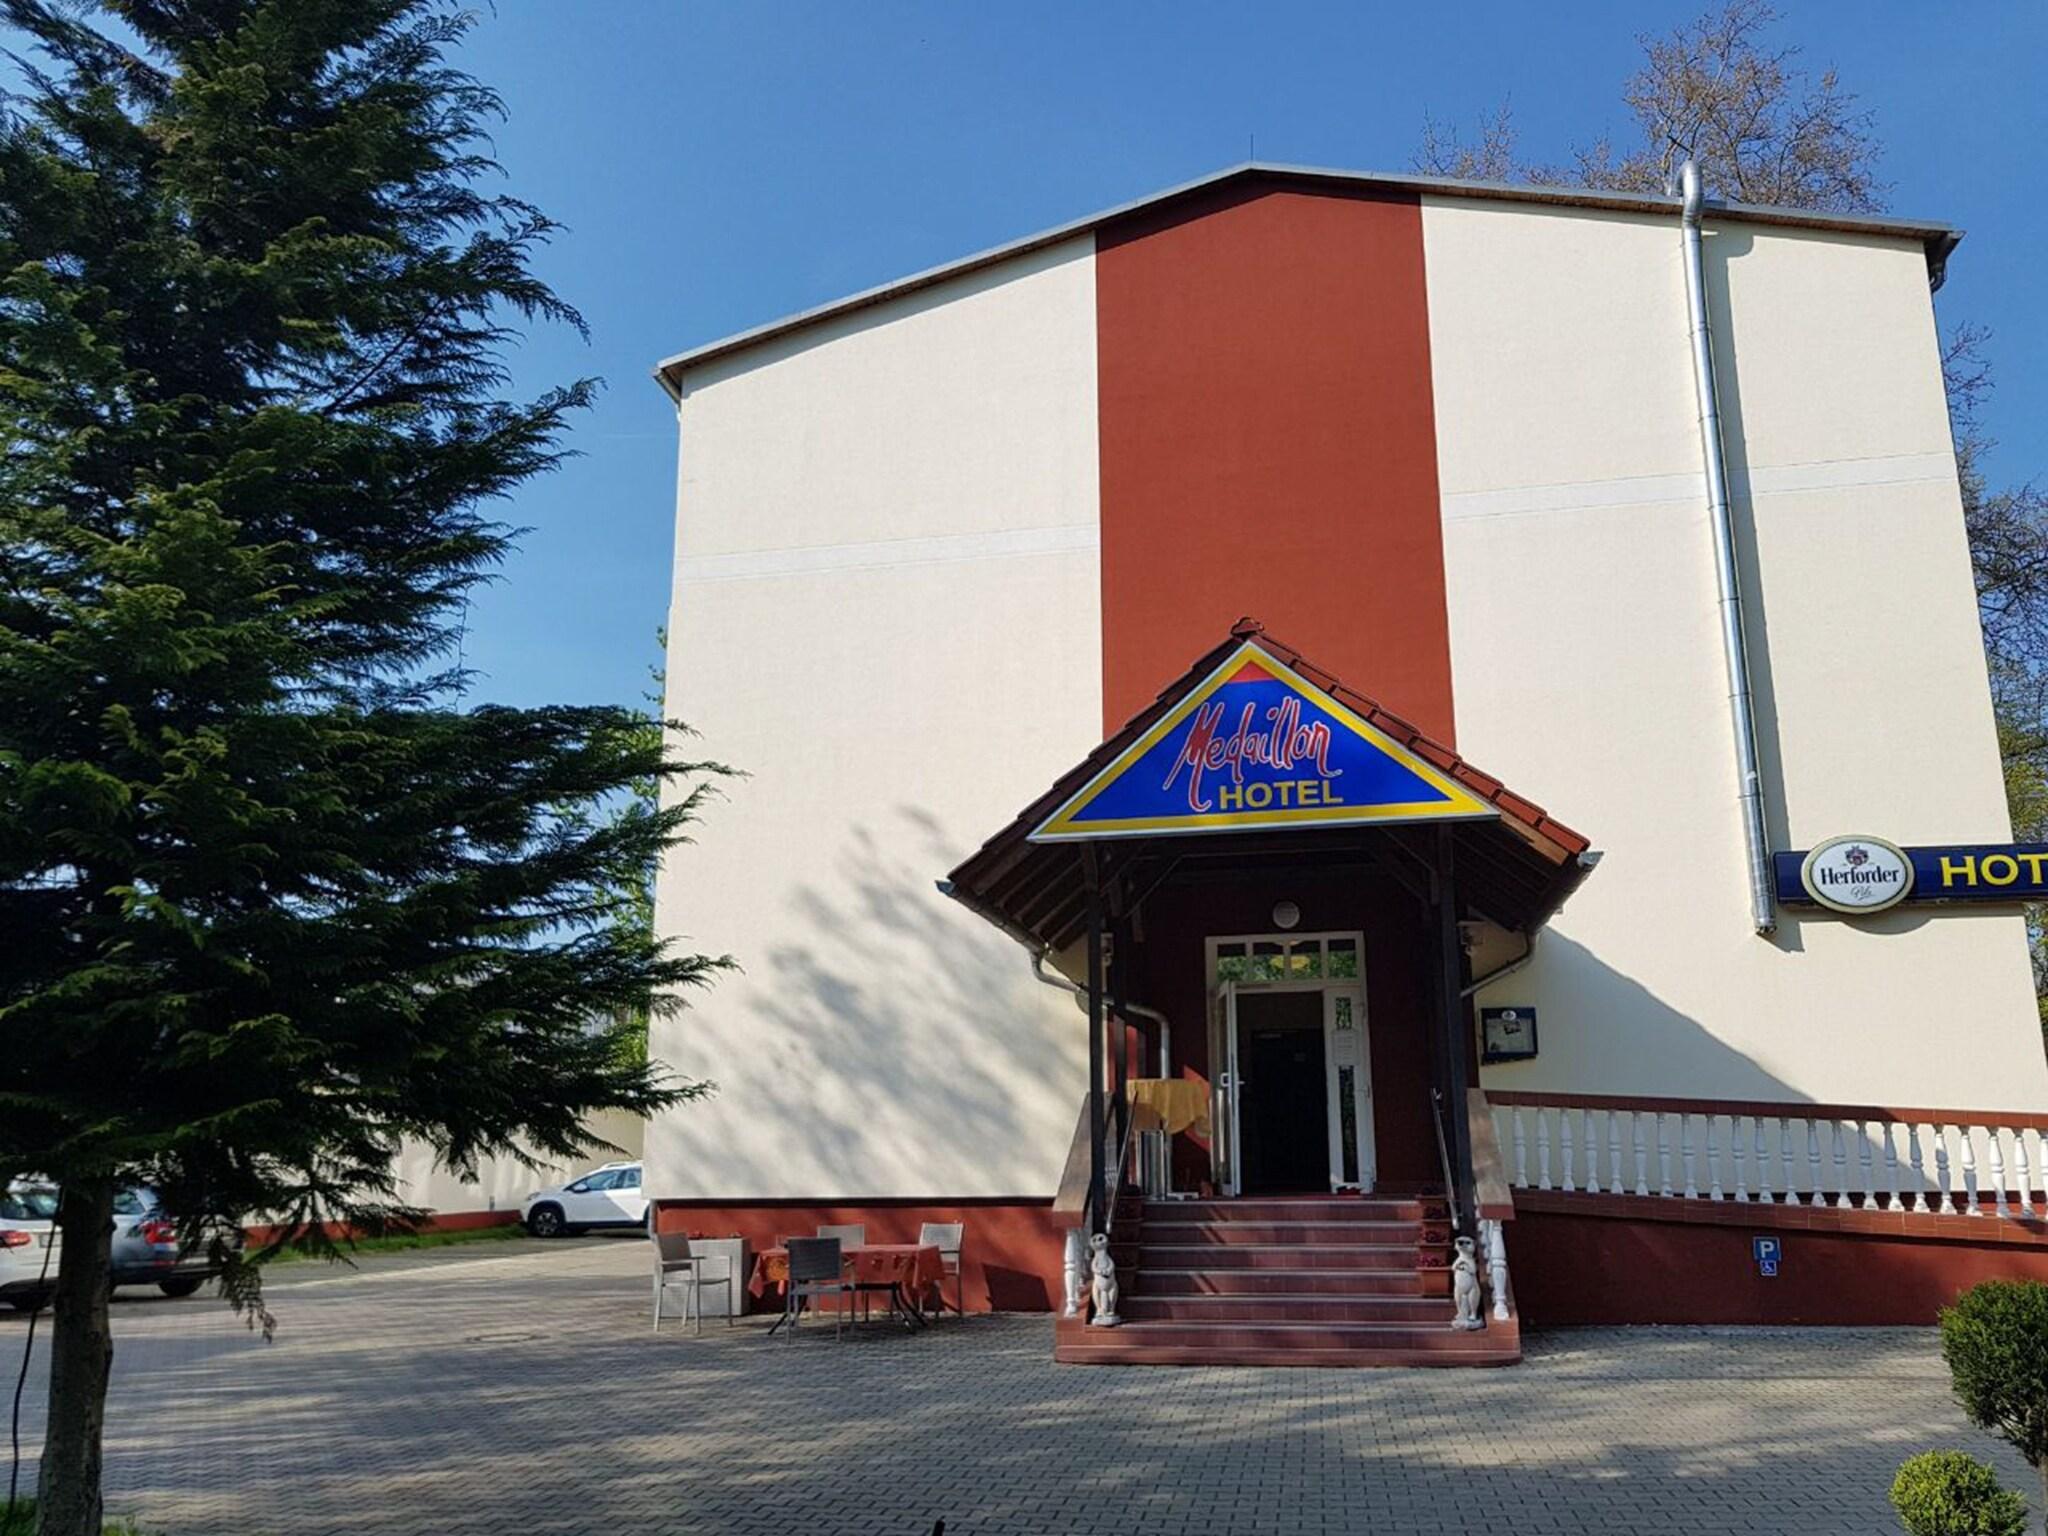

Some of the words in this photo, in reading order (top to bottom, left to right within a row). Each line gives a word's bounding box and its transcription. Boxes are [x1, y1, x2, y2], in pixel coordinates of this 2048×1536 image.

[1163, 696, 1343, 812] Medaillon
[1219, 779, 1344, 811] HOTEL
[1820, 866, 1899, 885] Herforder
[1940, 853, 2048, 887] HOT
[1760, 1241, 1774, 1259] P
